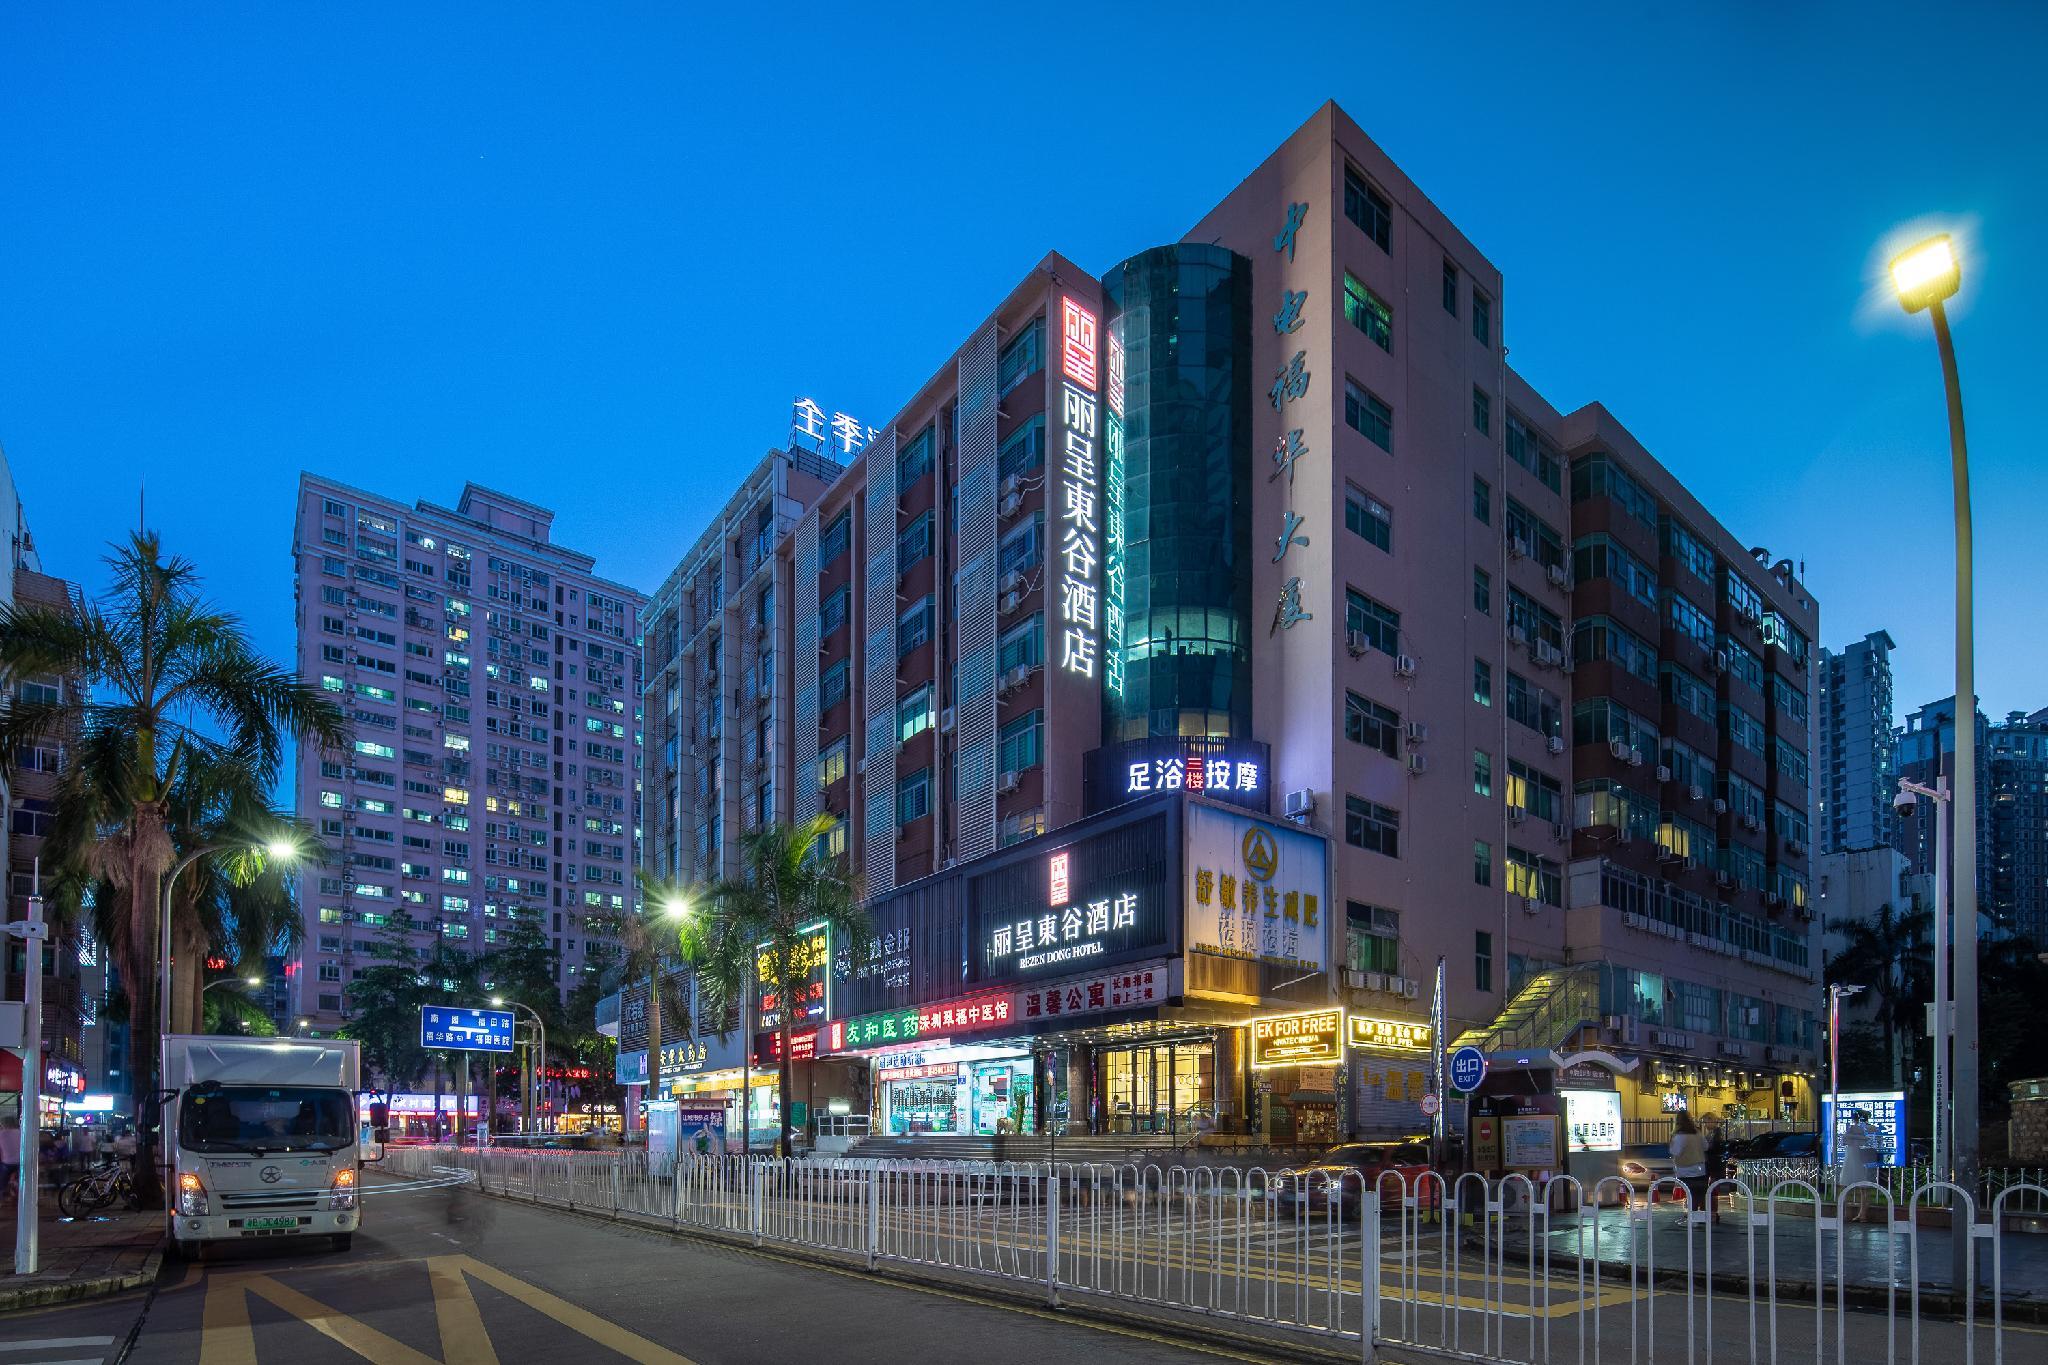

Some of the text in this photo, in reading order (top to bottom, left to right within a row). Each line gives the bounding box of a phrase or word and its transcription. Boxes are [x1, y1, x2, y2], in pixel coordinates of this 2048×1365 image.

[1128, 758, 1184, 793] 足浴
[1186, 757, 1204, 789] 三楼
[1206, 759, 1258, 791] 按摩
[1047, 947, 1072, 963] DONG
[1072, 941, 1104, 958] HOTEL
[1026, 981, 1106, 1017] 温馨公寓
[478, 1017, 510, 1029] 福田路
[846, 1013, 920, 1044] 友和医药
[1257, 1023, 1275, 1038] EK
[1275, 1019, 1301, 1037] FOR
[1302, 1016, 1336, 1034] FREE
[475, 1034, 511, 1046] 福田医院
[1456, 1058, 1479, 1073] 出口
[1458, 1075, 1476, 1083] EXIT
